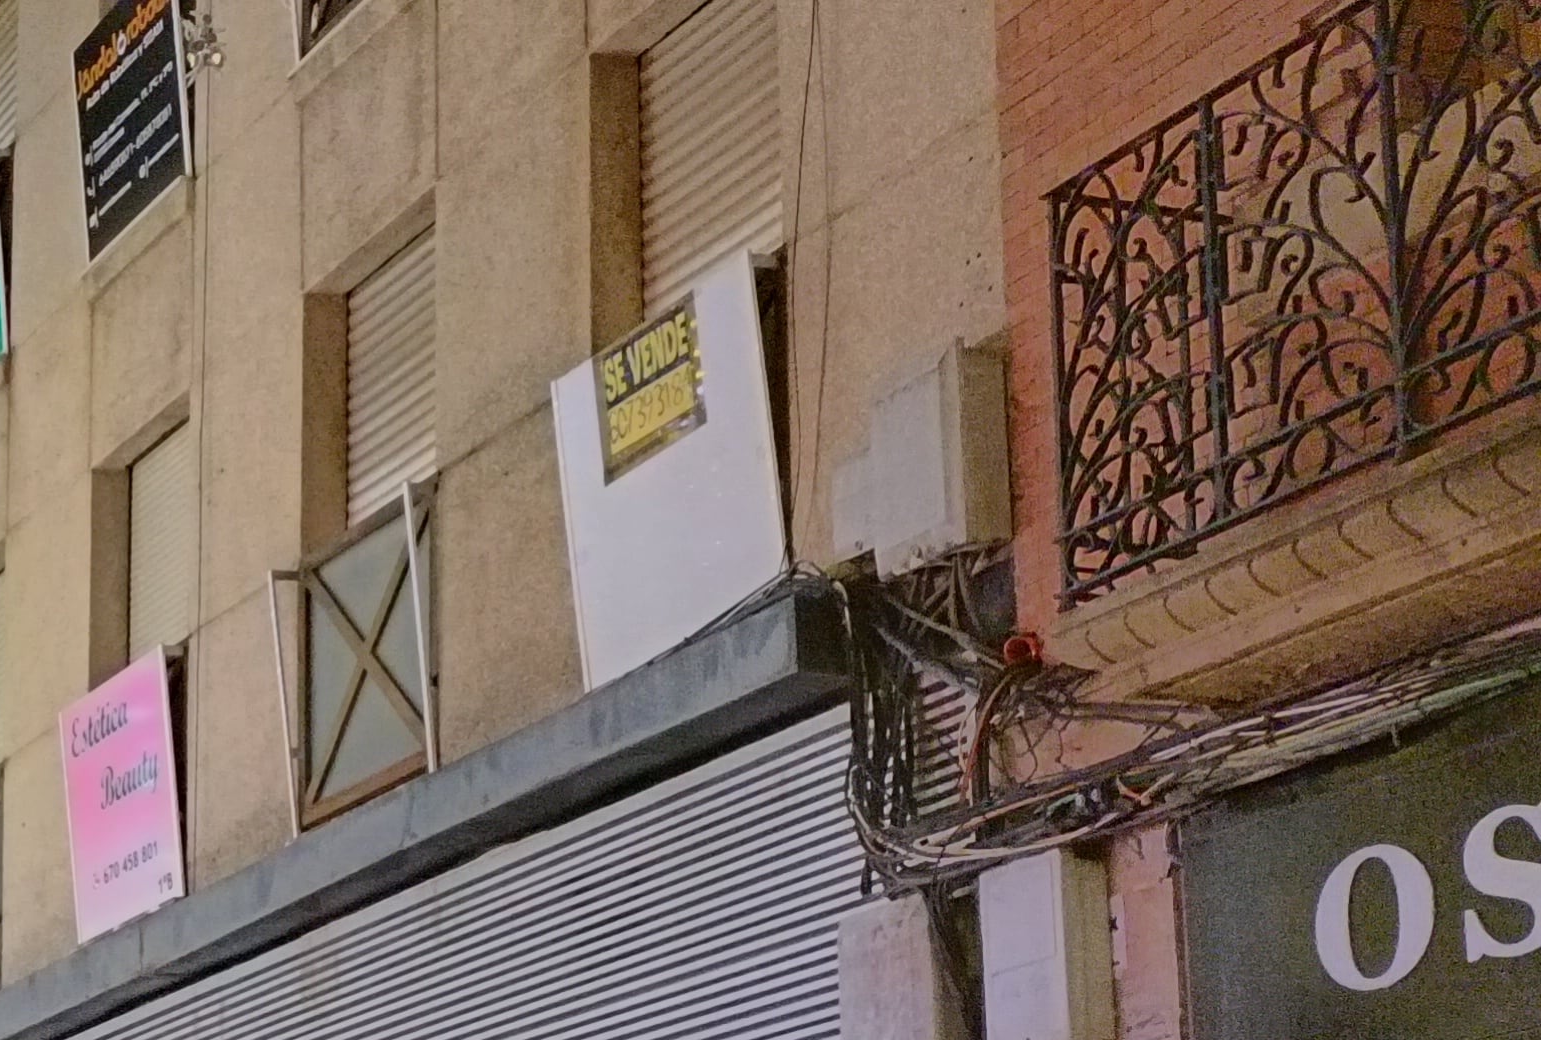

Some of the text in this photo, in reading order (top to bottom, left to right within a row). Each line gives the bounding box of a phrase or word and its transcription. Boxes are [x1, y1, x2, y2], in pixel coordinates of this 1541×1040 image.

[604, 312, 691, 403] SE VENDE
[71, 702, 128, 758] Estética
[100, 750, 158, 810] Beauty
[103, 861, 120, 884] 670
[141, 841, 158, 863] 801
